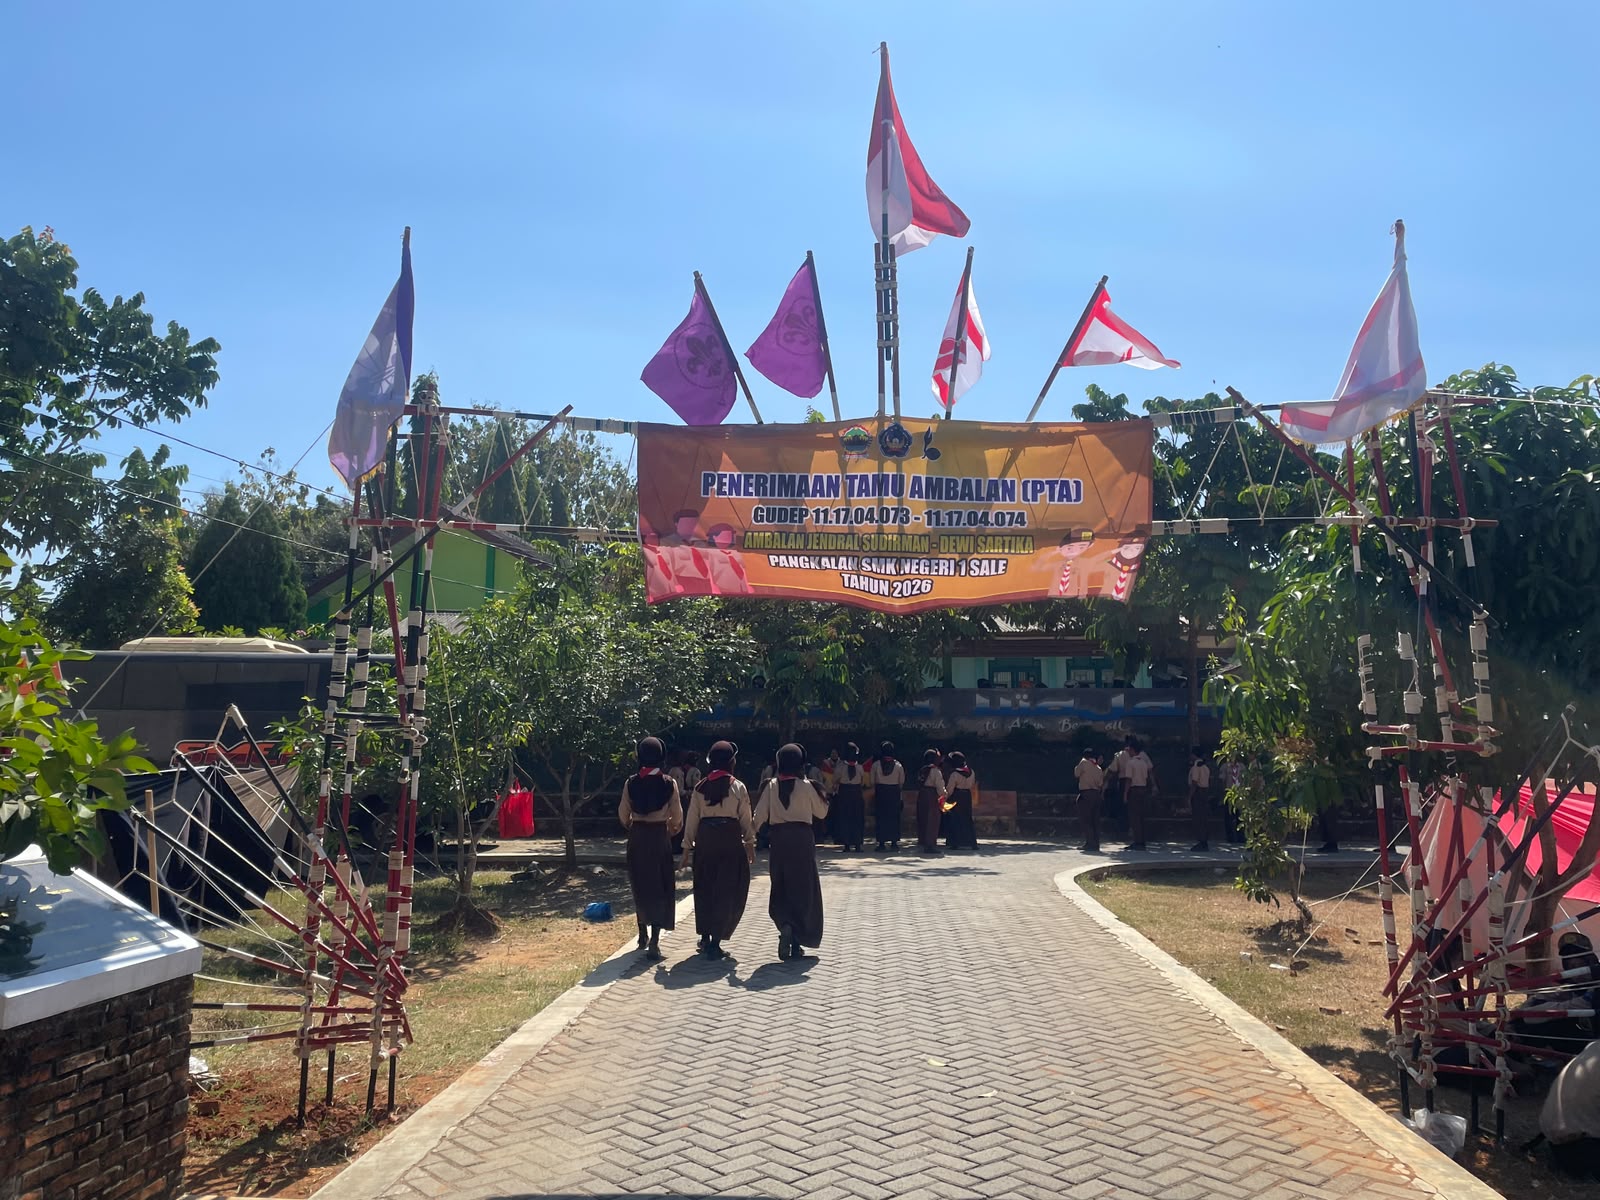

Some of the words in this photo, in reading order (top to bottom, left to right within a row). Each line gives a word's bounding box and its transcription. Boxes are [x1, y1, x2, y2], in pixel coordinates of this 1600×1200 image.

[702, 472, 841, 499] PENERIMAAN
[845, 473, 905, 500] TAMU
[909, 475, 1016, 502] AMBALAN
[1021, 478, 1082, 504] (PTA)
[752, 505, 809, 525] GUDEP
[812, 505, 911, 526] 11.17.04.073
[924, 509, 1027, 528] 11.17.04.074
[743, 532, 805, 550] AMBALAN
[807, 532, 860, 551] JENDRAL
[862, 533, 930, 553] SUDIRMAN
[939, 535, 975, 554] DEWI
[976, 536, 1034, 555] SARTIKA
[768, 554, 860, 572] PANGKALAN
[861, 556, 898, 575] SMK
[899, 558, 956, 576] NEGERI
[958, 559, 967, 576] 1
[968, 558, 1008, 576] SALE
[841, 573, 891, 597] TAHUN
[892, 579, 934, 598] 2026
